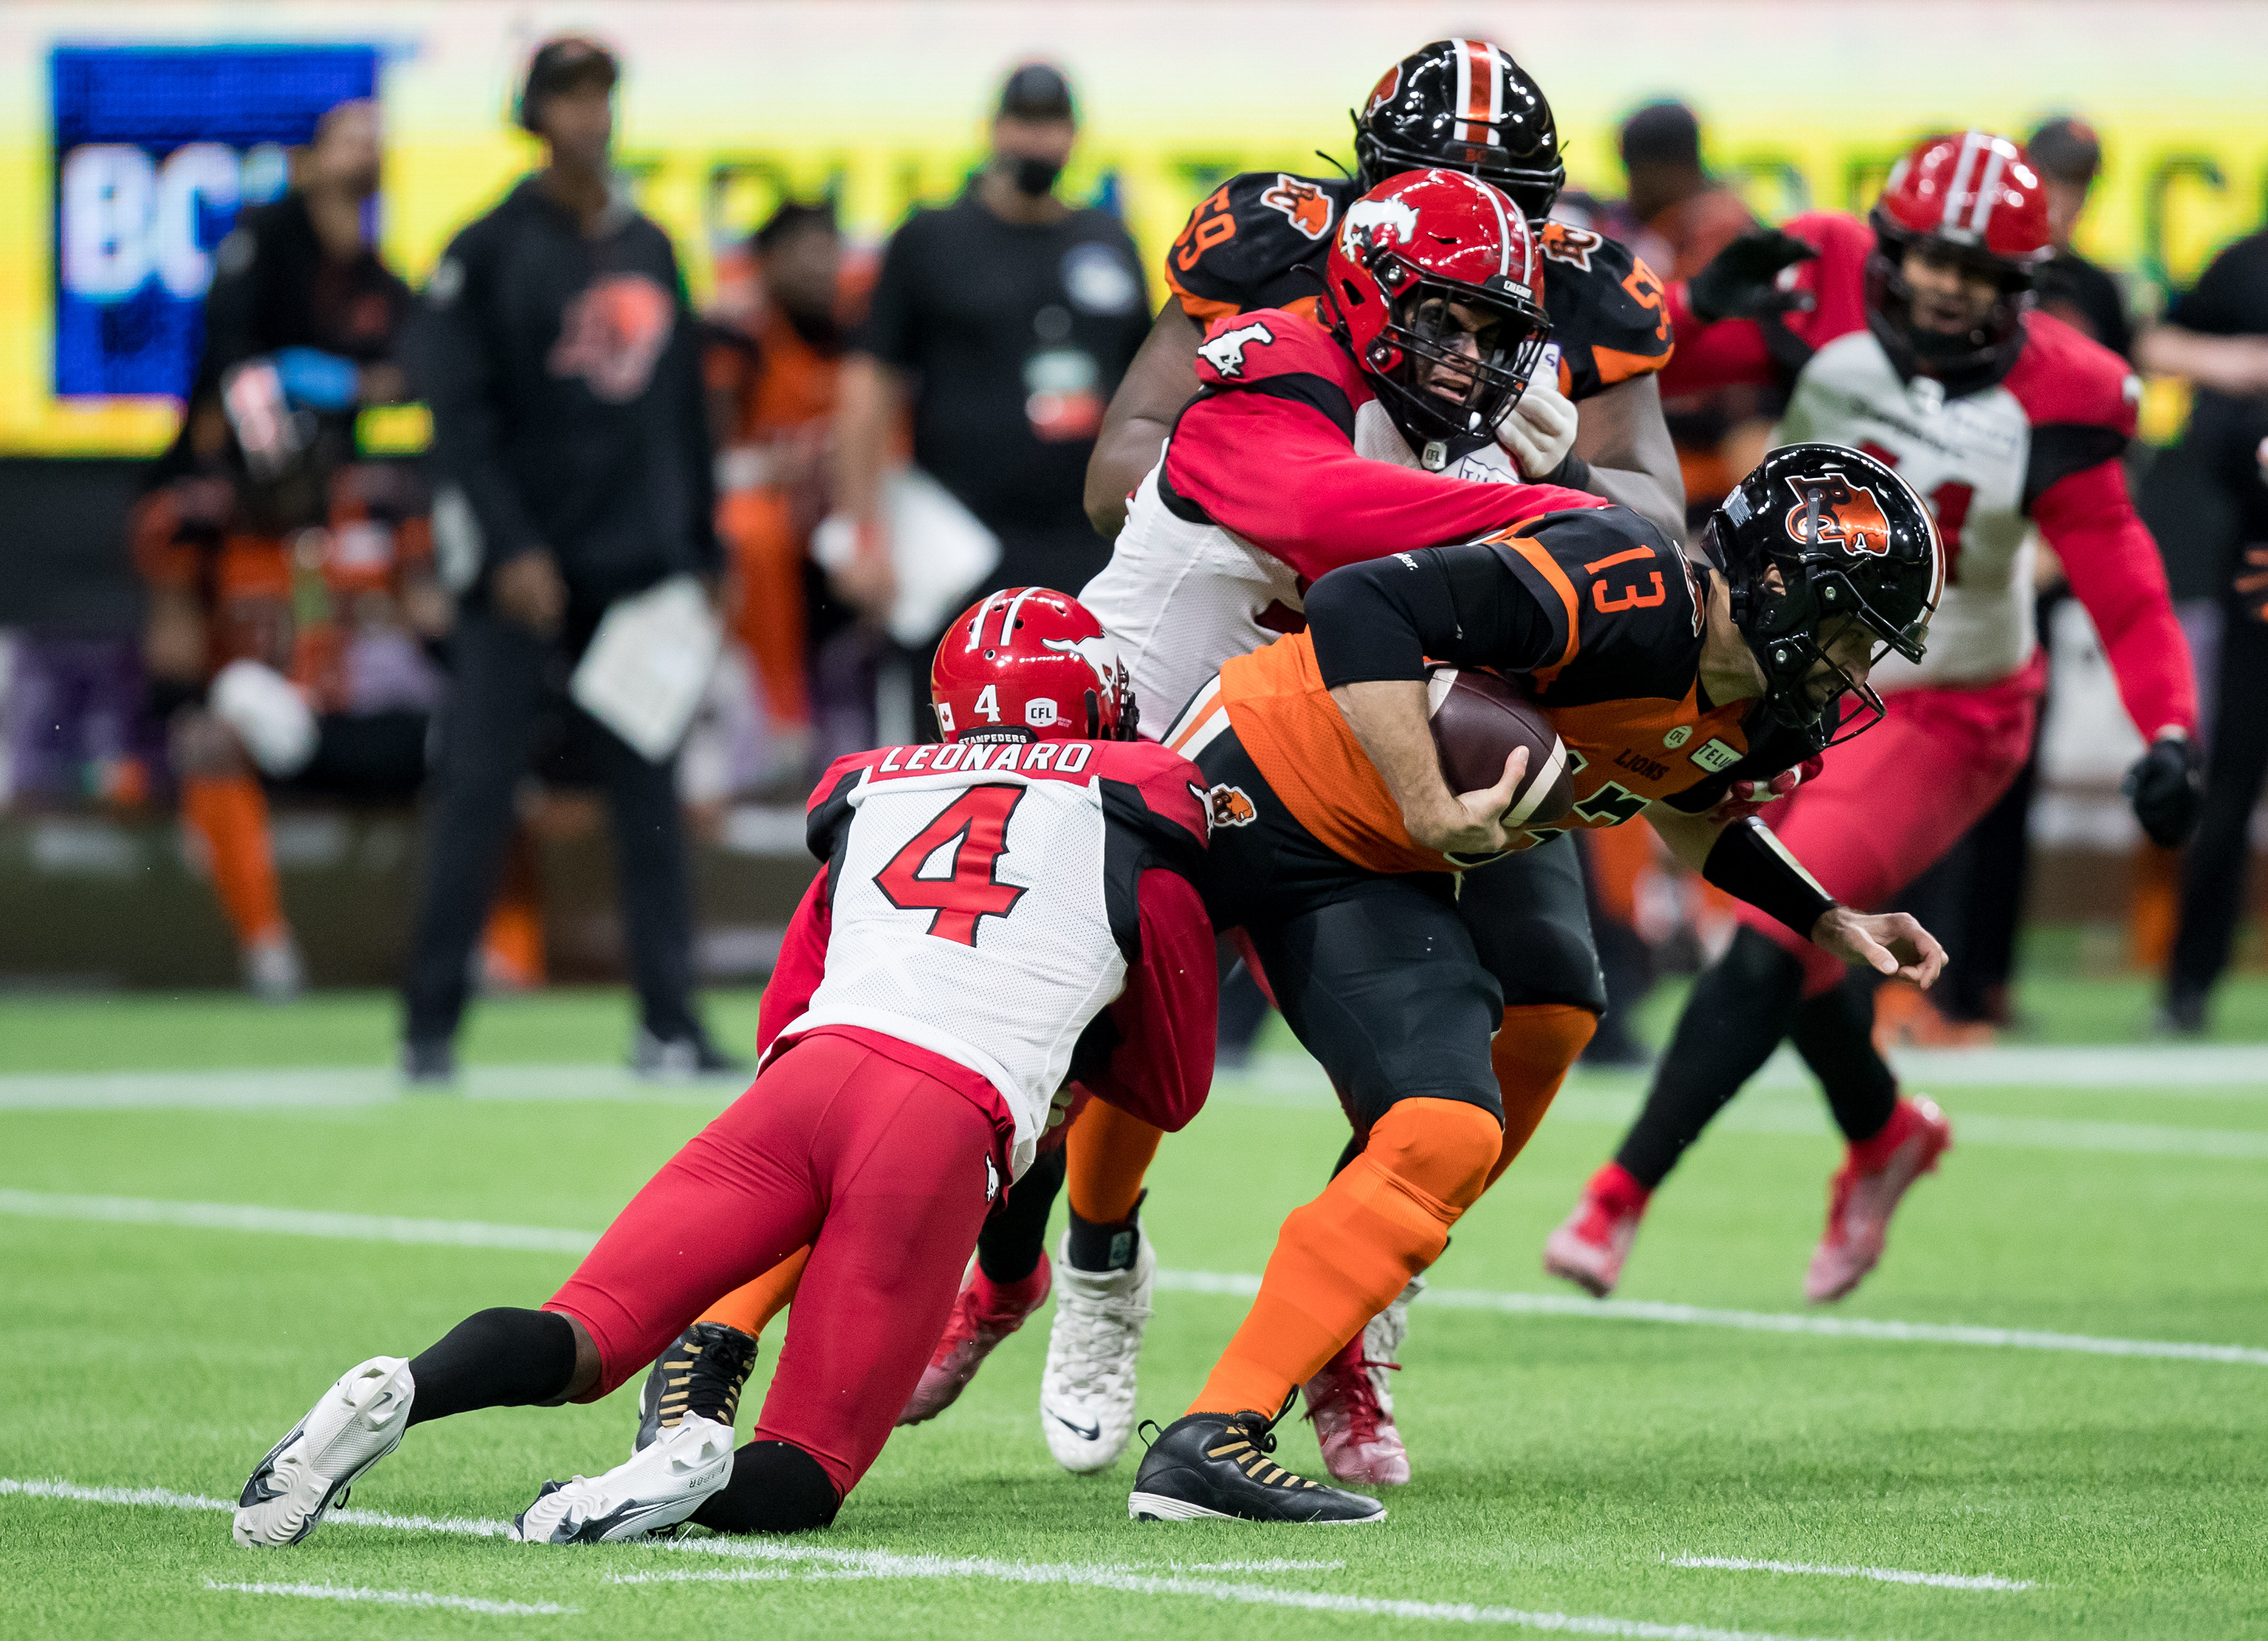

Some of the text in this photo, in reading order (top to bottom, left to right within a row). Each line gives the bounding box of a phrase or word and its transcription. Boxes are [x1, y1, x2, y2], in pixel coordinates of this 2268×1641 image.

[1175, 186, 1236, 271] 59
[1583, 544, 1666, 614] 13
[974, 684, 1002, 723] 4
[1030, 707, 1052, 718] CFL
[958, 734, 1027, 744] STAMPEDERS
[1669, 730, 1685, 743] CFL
[878, 743, 1094, 774] LEONARD
[1613, 748, 1671, 781] LIONS
[1698, 744, 1735, 768] TELU
[871, 782, 1030, 948] 4
